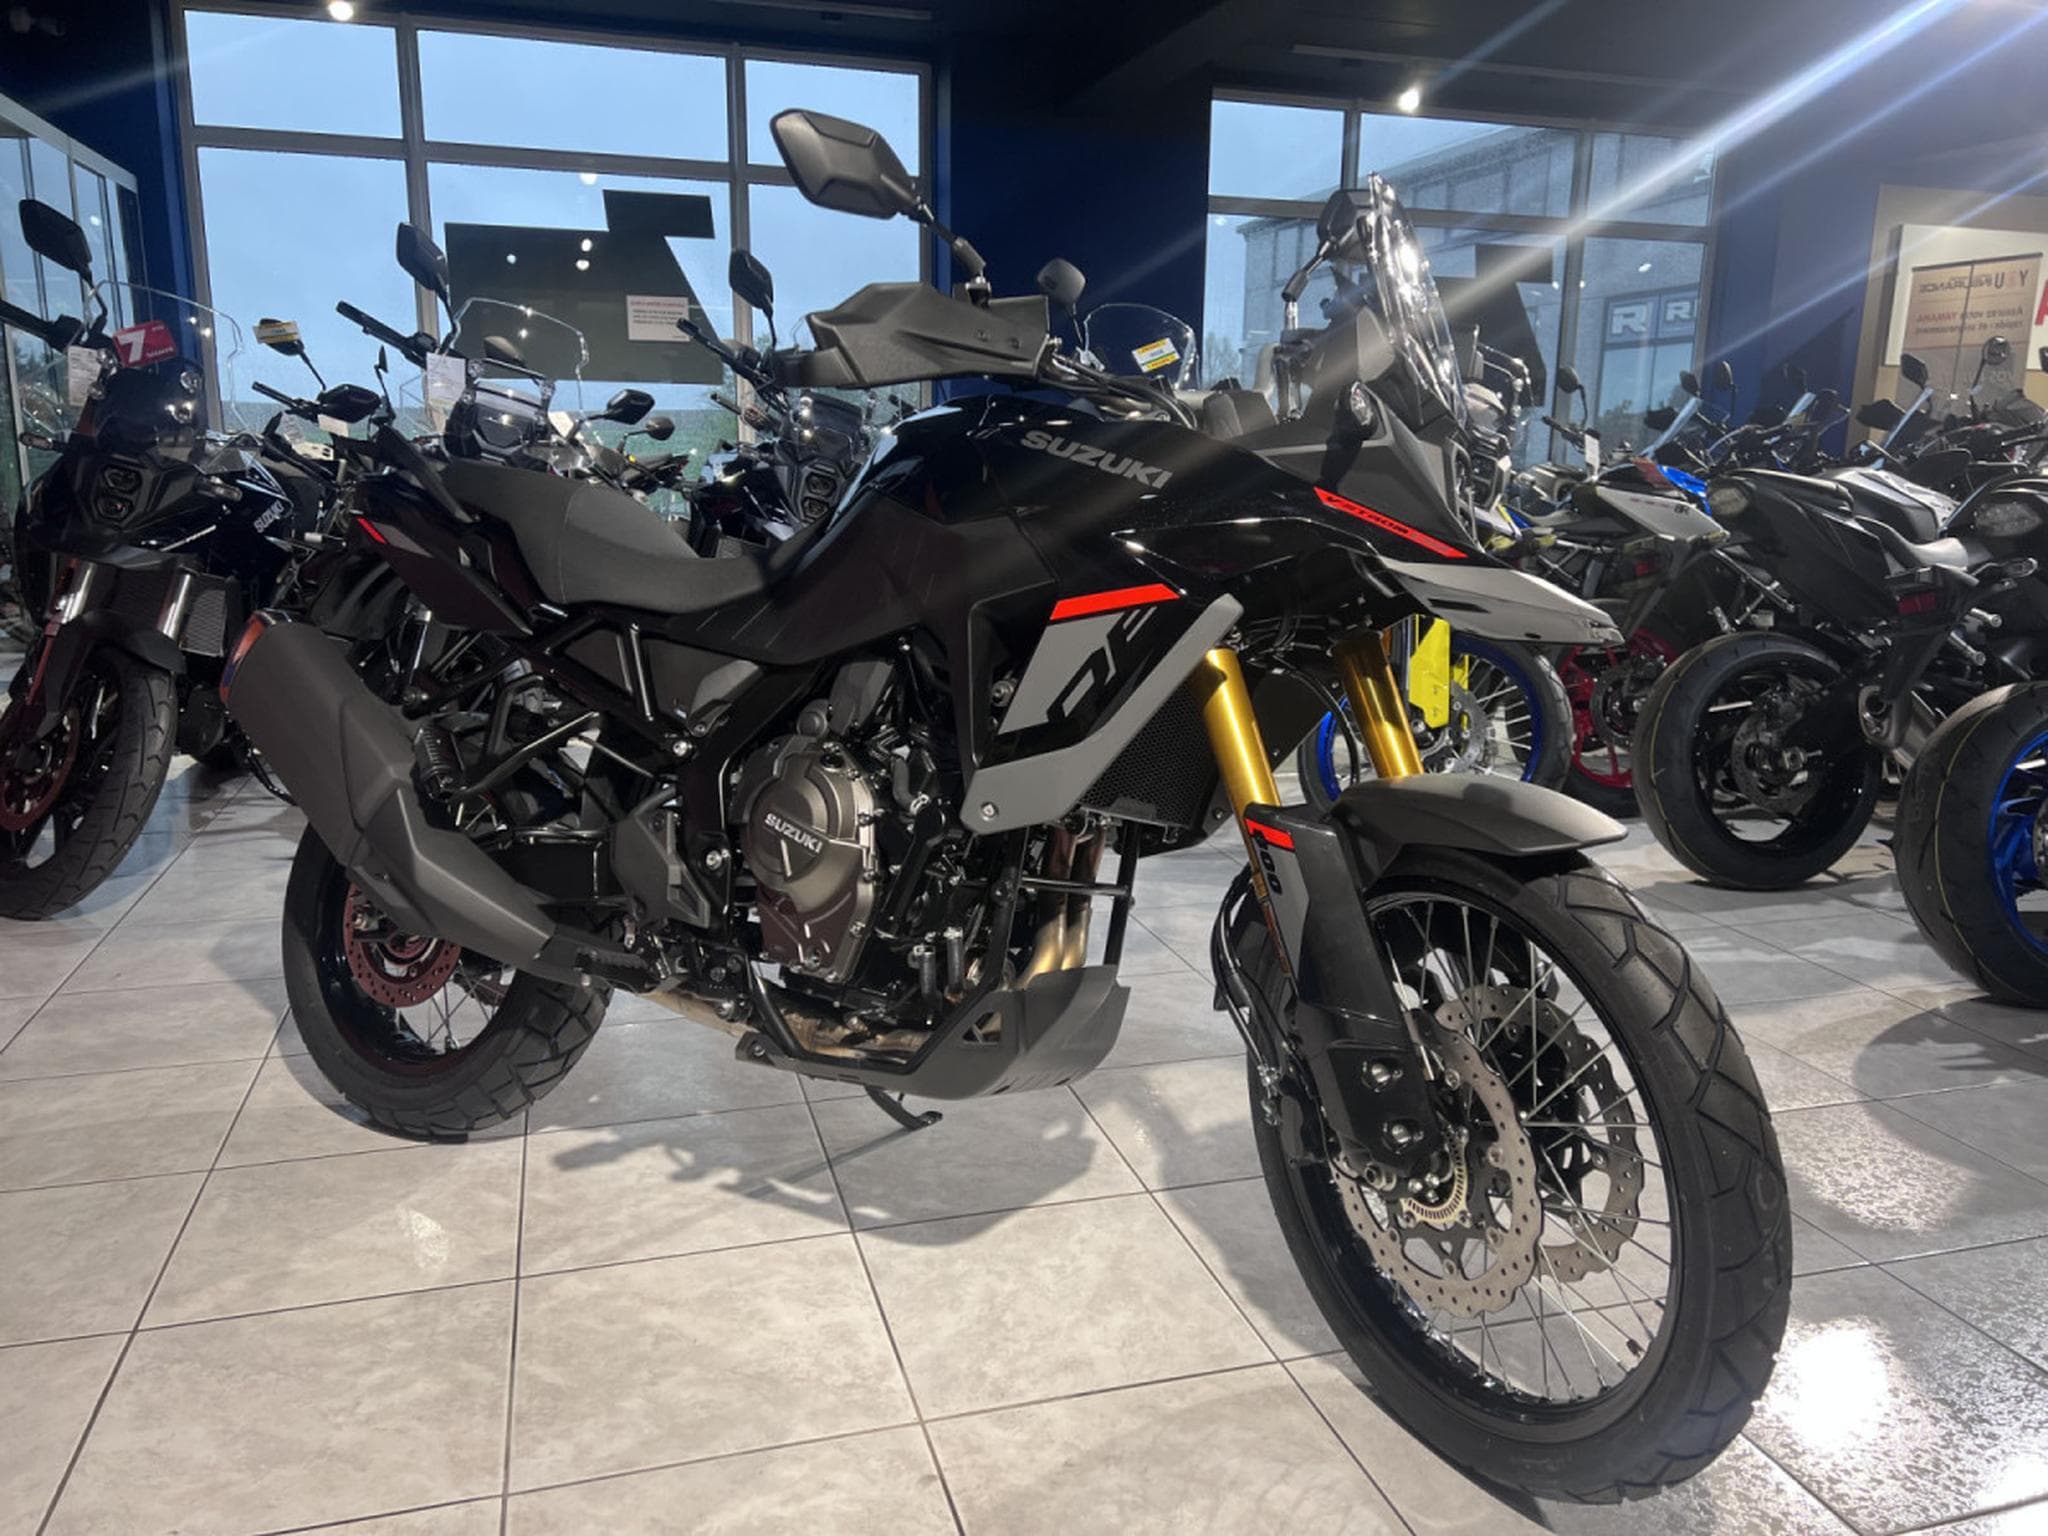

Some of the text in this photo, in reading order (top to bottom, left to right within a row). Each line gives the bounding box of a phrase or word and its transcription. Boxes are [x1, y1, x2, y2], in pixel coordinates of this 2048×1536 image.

[117, 329, 146, 363] 7
[1020, 430, 1173, 489] SUZUKI
[764, 813, 823, 853] SUZUKI
